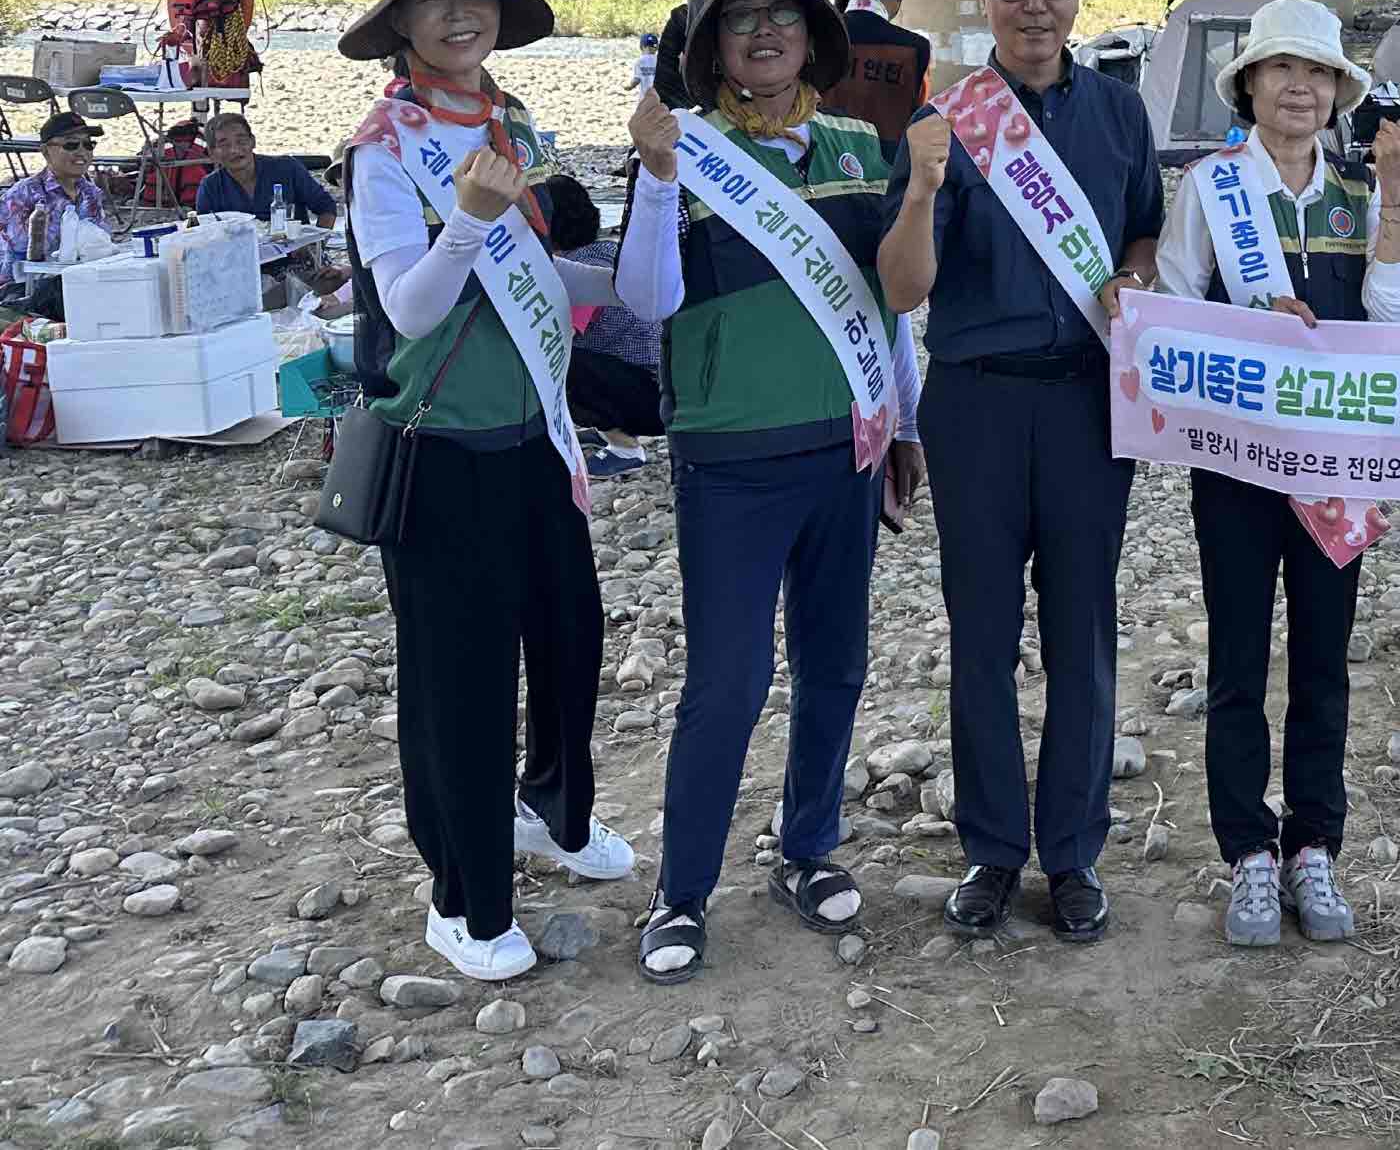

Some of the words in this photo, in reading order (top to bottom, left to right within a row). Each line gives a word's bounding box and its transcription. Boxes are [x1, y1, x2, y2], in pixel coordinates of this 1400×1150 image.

[1004, 149, 1074, 234] 밀양시
[1211, 162, 1269, 283] 살기좋은
[673, 132, 759, 205] 기좋은
[755, 199, 853, 312] 살고싶은
[843, 310, 885, 402] 하남읍
[1149, 345, 1266, 412] 살기좋은
[1275, 365, 1398, 425] 살고싶은
[1247, 442, 1339, 477] 하남읍으로
